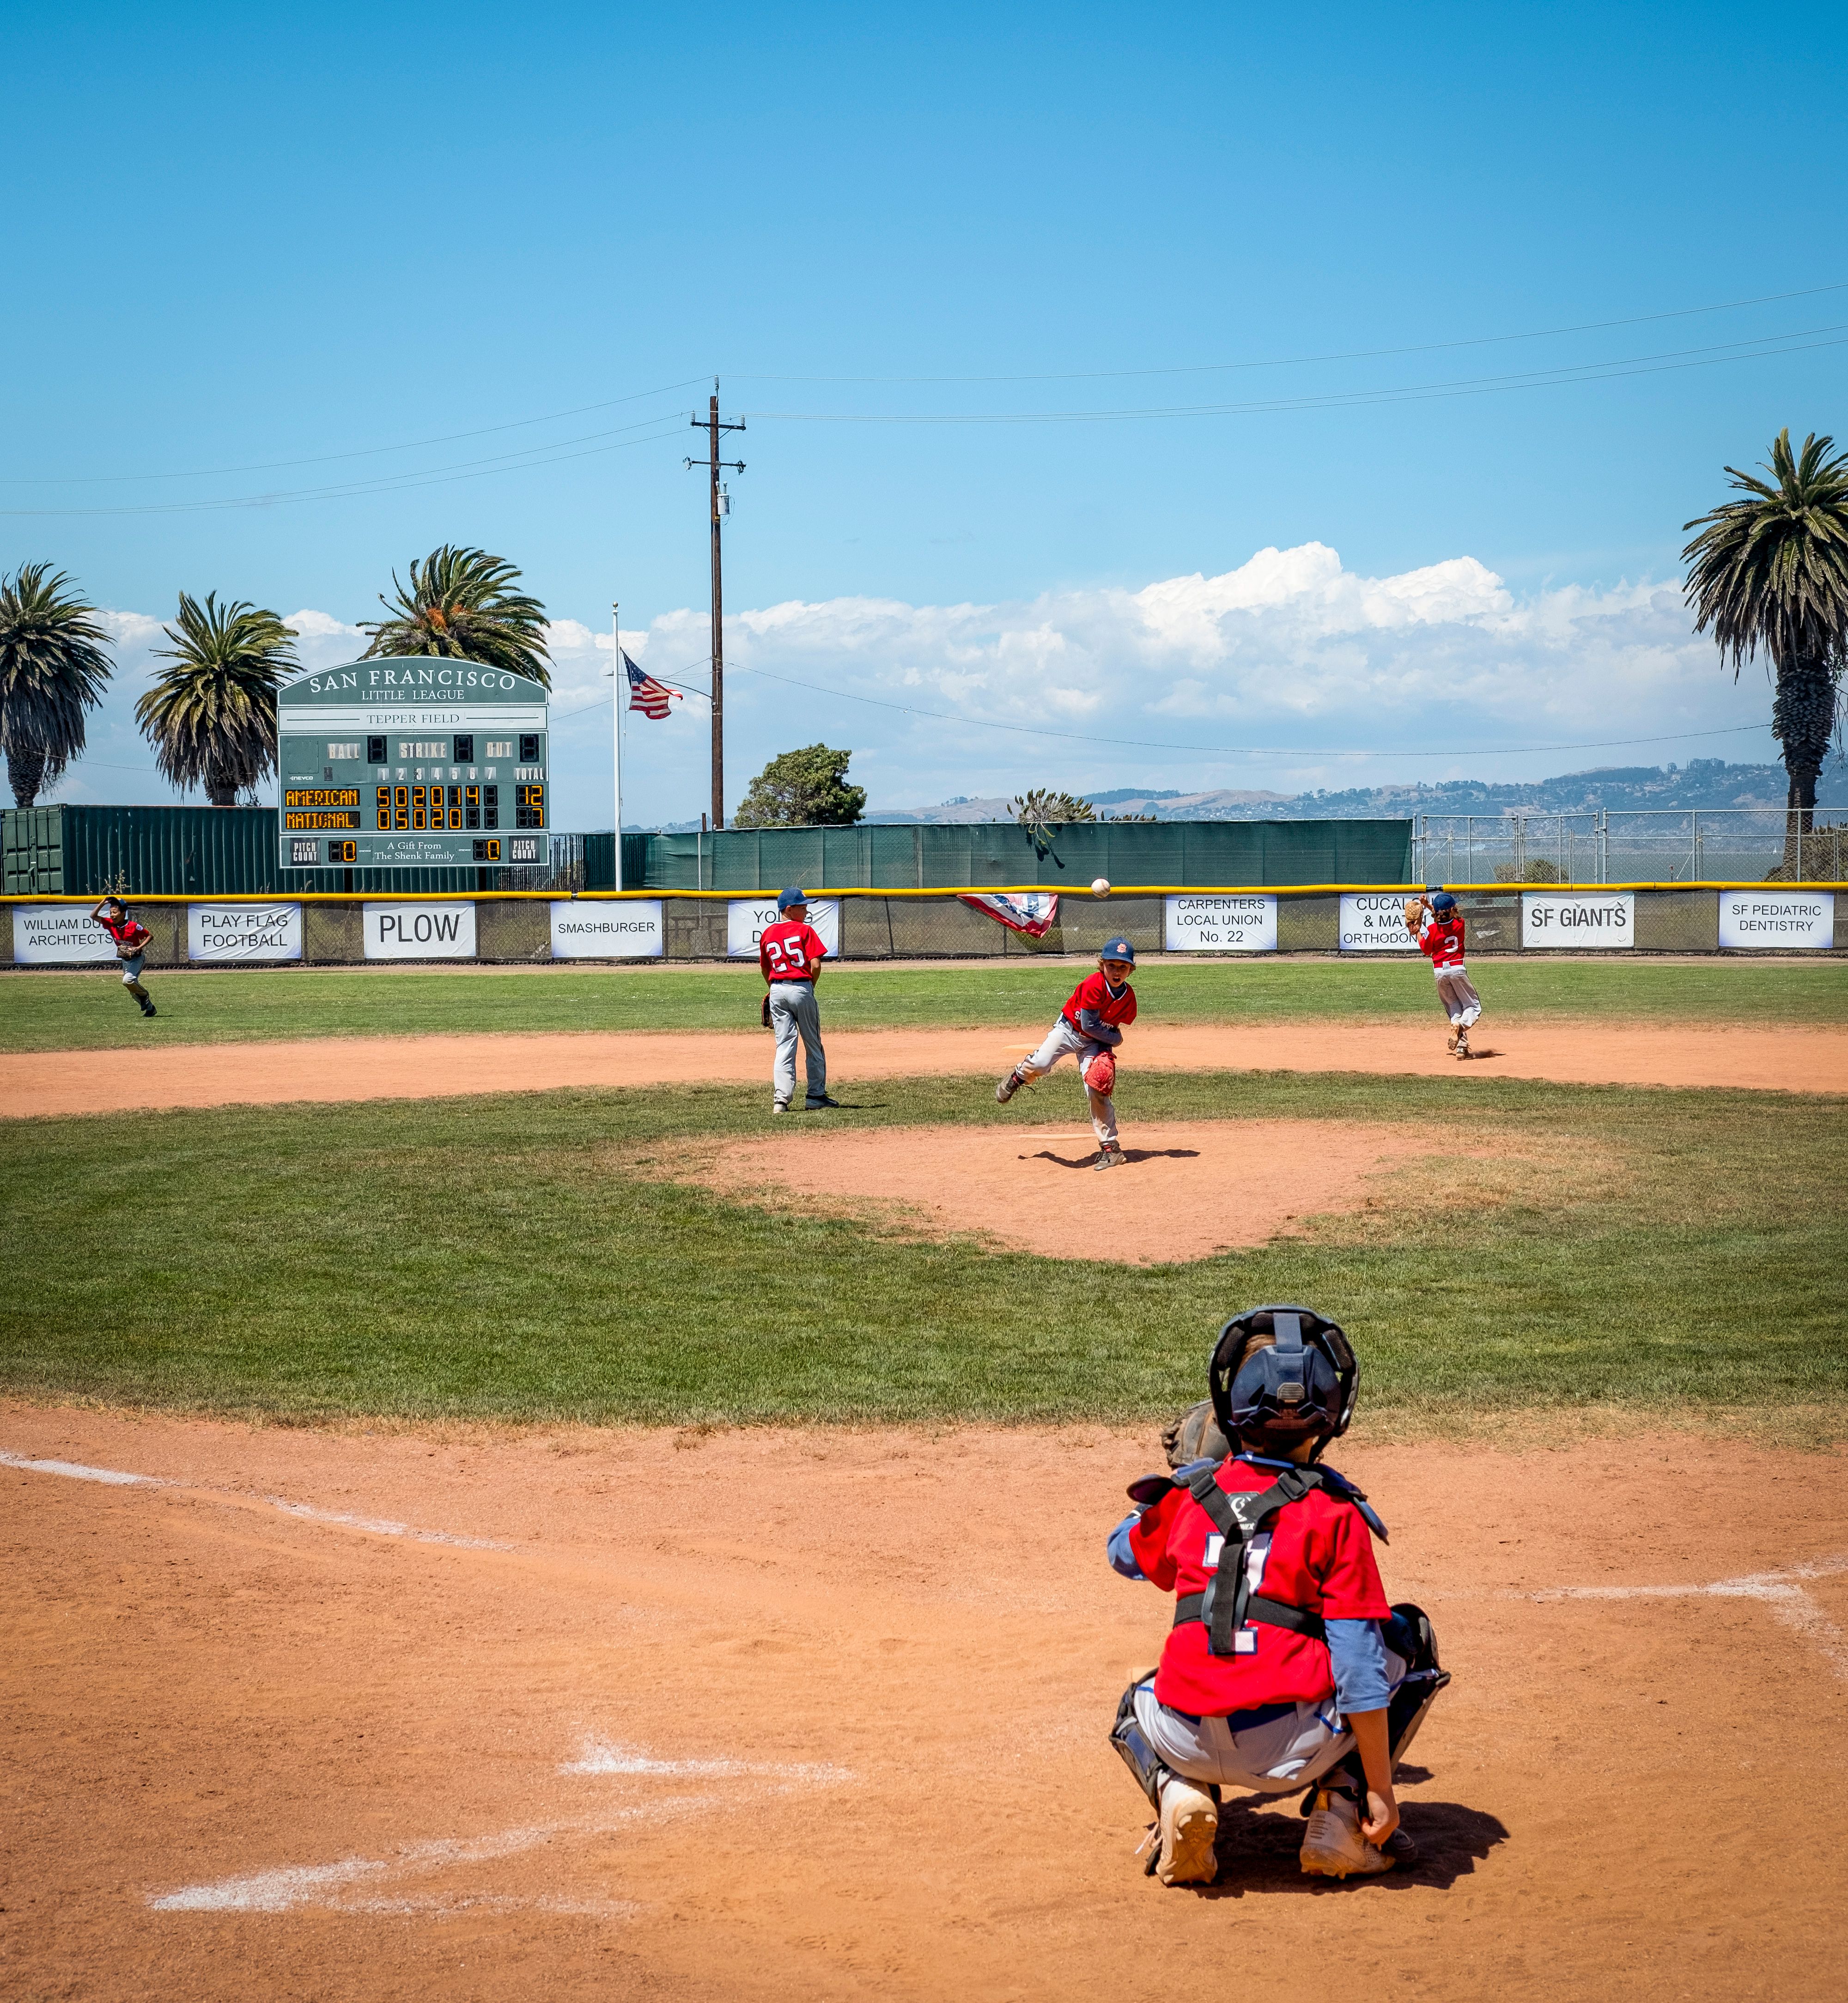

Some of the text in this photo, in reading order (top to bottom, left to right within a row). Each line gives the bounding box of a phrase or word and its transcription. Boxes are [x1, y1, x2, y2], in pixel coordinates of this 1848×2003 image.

[309, 669, 516, 693] SAN FRANCISCO
[361, 690, 465, 700] LITTLE LEAGUE
[366, 714, 460, 724] TEPPER FIELD
[328, 742, 511, 759] BALL STRIKE OUT
[398, 768, 404, 781] 2
[416, 768, 422, 780] 3
[434, 768, 440, 780] 4
[451, 768, 458, 780] 5
[469, 768, 475, 780] 6
[487, 768, 493, 780] 7
[515, 768, 544, 780] TOTAL
[377, 787, 389, 807] 5
[395, 787, 407, 807] 0
[413, 787, 425, 807] 2
[431, 787, 443, 806] 0
[466, 787, 478, 805] 4
[525, 786, 542, 805] 12
[378, 809, 389, 829] 0
[396, 809, 407, 829] 5
[413, 809, 425, 829] 0
[432, 809, 443, 828] 2
[450, 809, 461, 828] 0
[532, 808, 543, 826] 7
[294, 842, 316, 852] PITCH
[387, 841, 395, 850] A
[397, 841, 415, 850] Gift
[487, 840, 499, 860] 0
[513, 840, 535, 850] PITCH
[293, 851, 317, 862] COUNT
[343, 841, 356, 862] 0
[374, 851, 455, 862] The Shenk Family
[512, 849, 536, 859] COUNT
[1178, 899, 1265, 910] CARPENTERS
[1732, 904, 1821, 916] SF PEDIATRIC
[201, 914, 288, 928] PLAY FLAG
[1177, 915, 1263, 925] LOCAL UNION
[1364, 915, 1374, 927] &
[1531, 908, 1626, 927] SF GIANTS
[24, 918, 101, 930] WILLIAM DU
[380, 914, 460, 942] PLOW
[558, 922, 655, 934] SMASHBURGER
[1739, 920, 1814, 931] DENTISTRY
[29, 934, 113, 946] ARCHITECTS
[203, 934, 287, 947] FOOTBALL
[1200, 930, 1244, 942] No. 22
[1444, 935, 1459, 953] 3
[766, 935, 805, 973] 25
